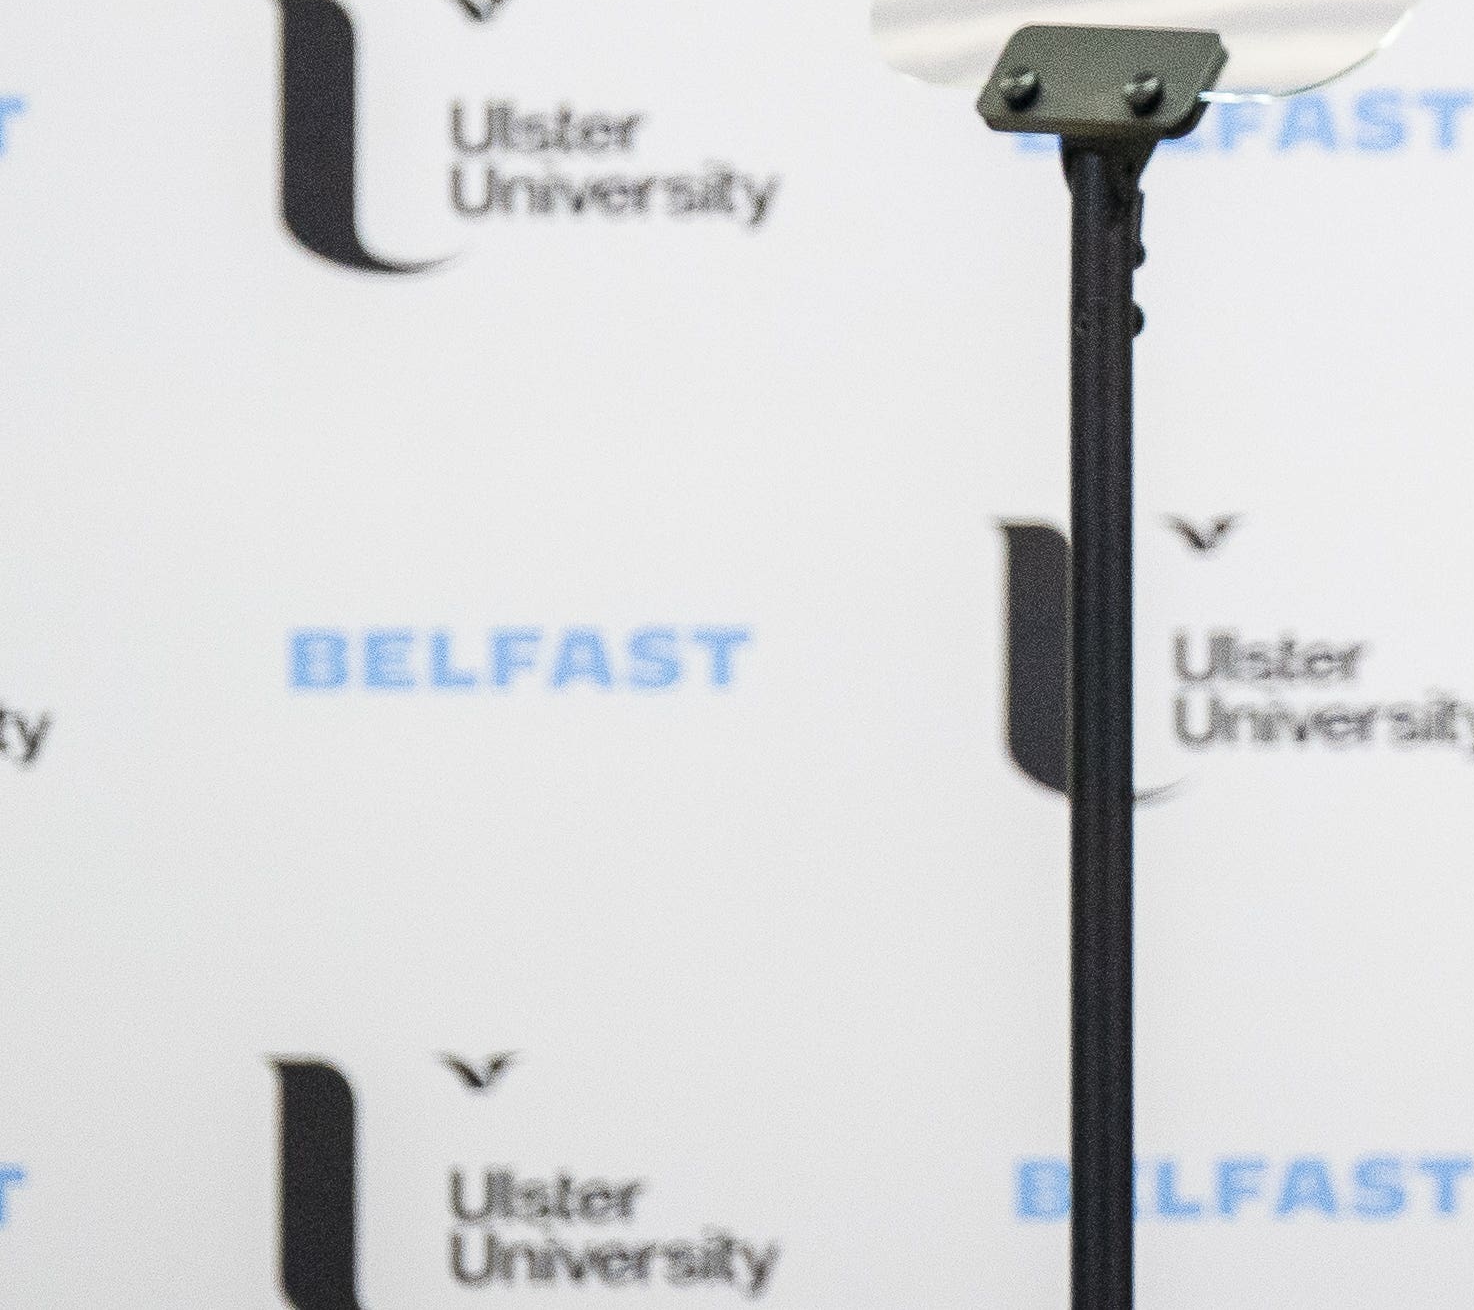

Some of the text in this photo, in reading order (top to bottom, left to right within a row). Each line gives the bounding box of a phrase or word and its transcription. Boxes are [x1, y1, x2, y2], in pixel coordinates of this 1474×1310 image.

[447, 98, 642, 156] Ulster
[447, 163, 777, 228] University
[285, 624, 752, 694] BELFAST
[1172, 629, 1366, 685] Ulster
[446, 1167, 643, 1227] Ulster
[446, 1230, 780, 1297] University
